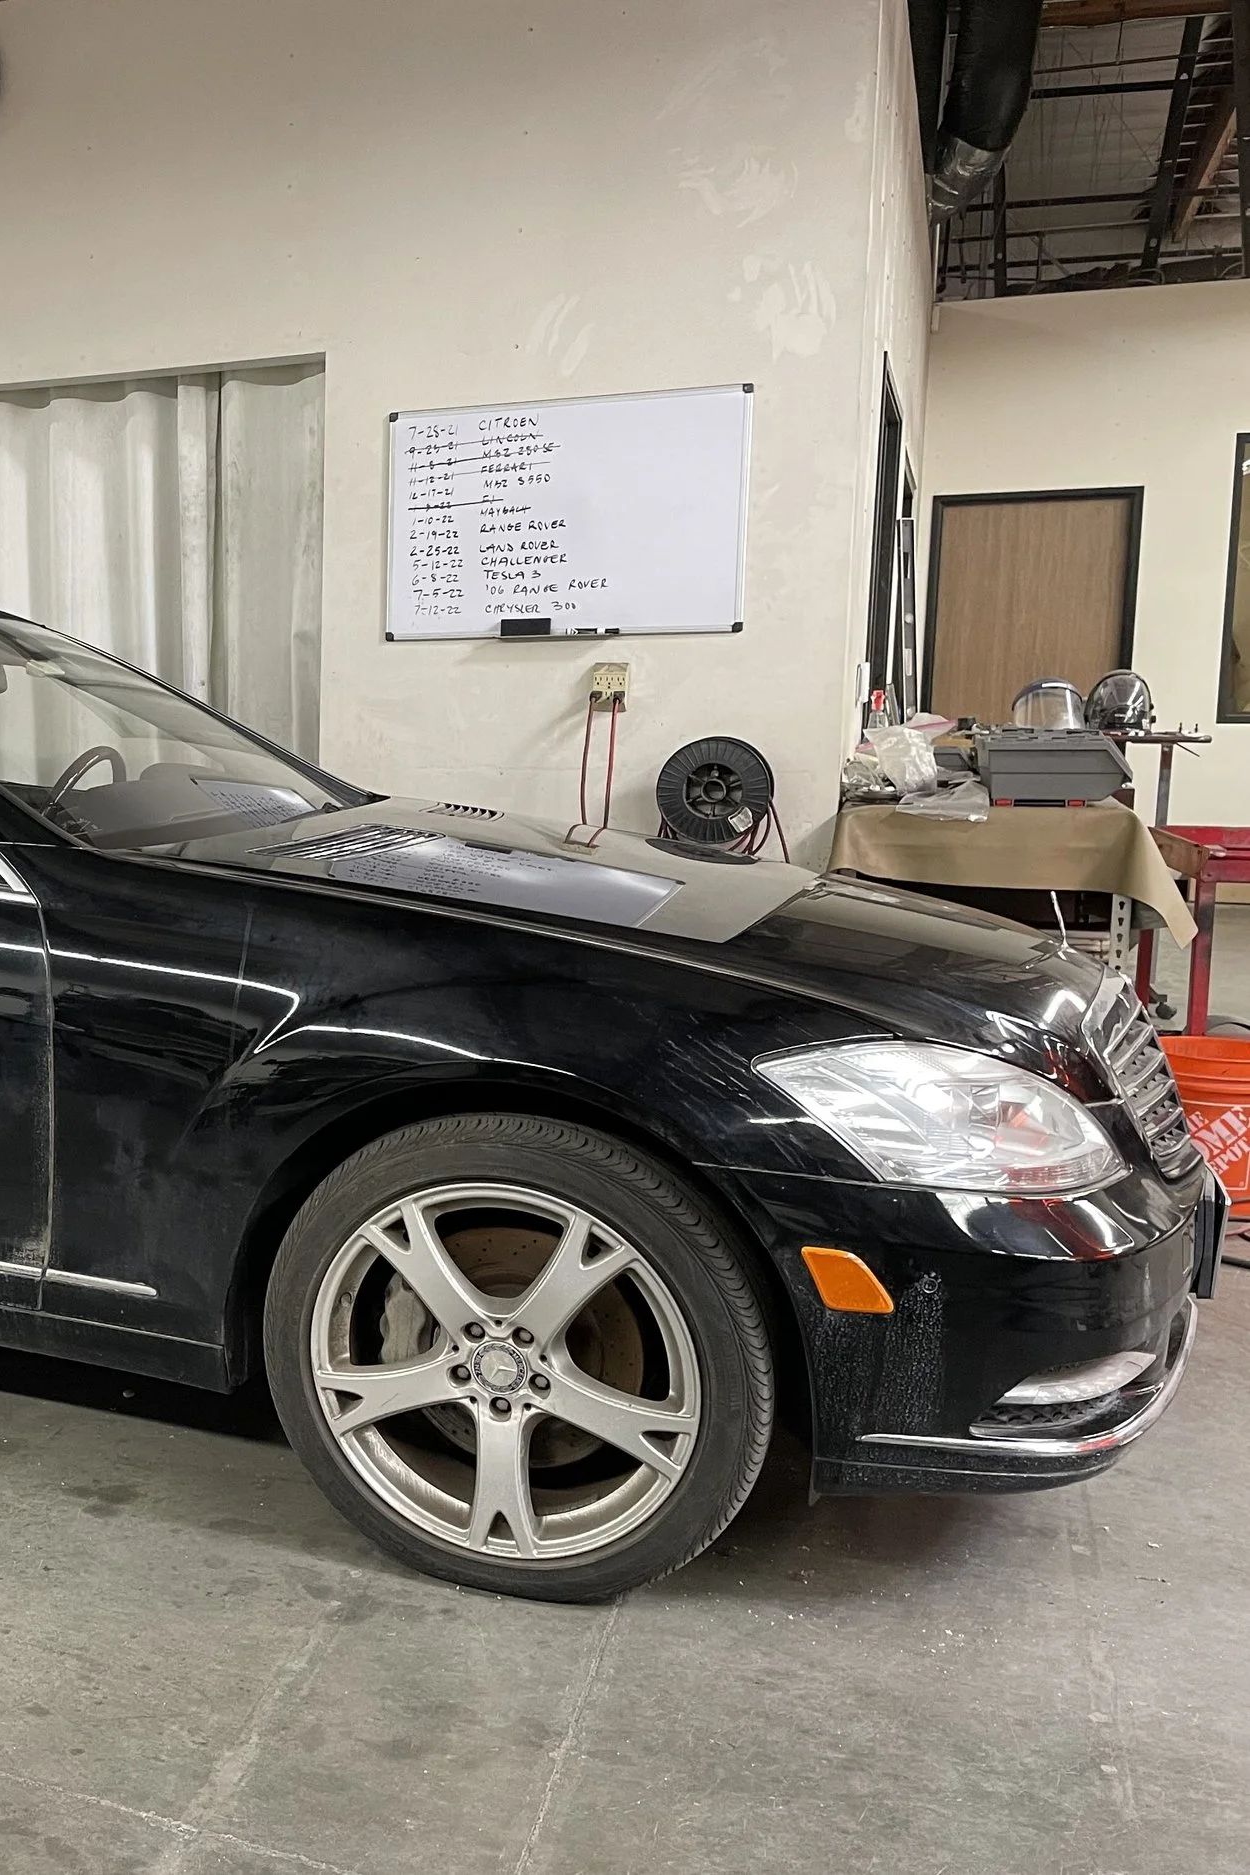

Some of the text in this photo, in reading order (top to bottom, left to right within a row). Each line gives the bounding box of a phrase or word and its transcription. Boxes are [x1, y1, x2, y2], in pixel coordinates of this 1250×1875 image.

[479, 413, 540, 432] CITROEN
[480, 521, 522, 534] RANGE
[528, 518, 567, 531] ROVER
[479, 542, 514, 553] LAND
[520, 539, 560, 551] ROVER
[481, 553, 568, 567] CHALLENGER
[484, 569, 525, 580] TESLA
[531, 570, 542, 579] 3
[513, 582, 559, 596] RANGE
[568, 577, 610, 591] ROVER
